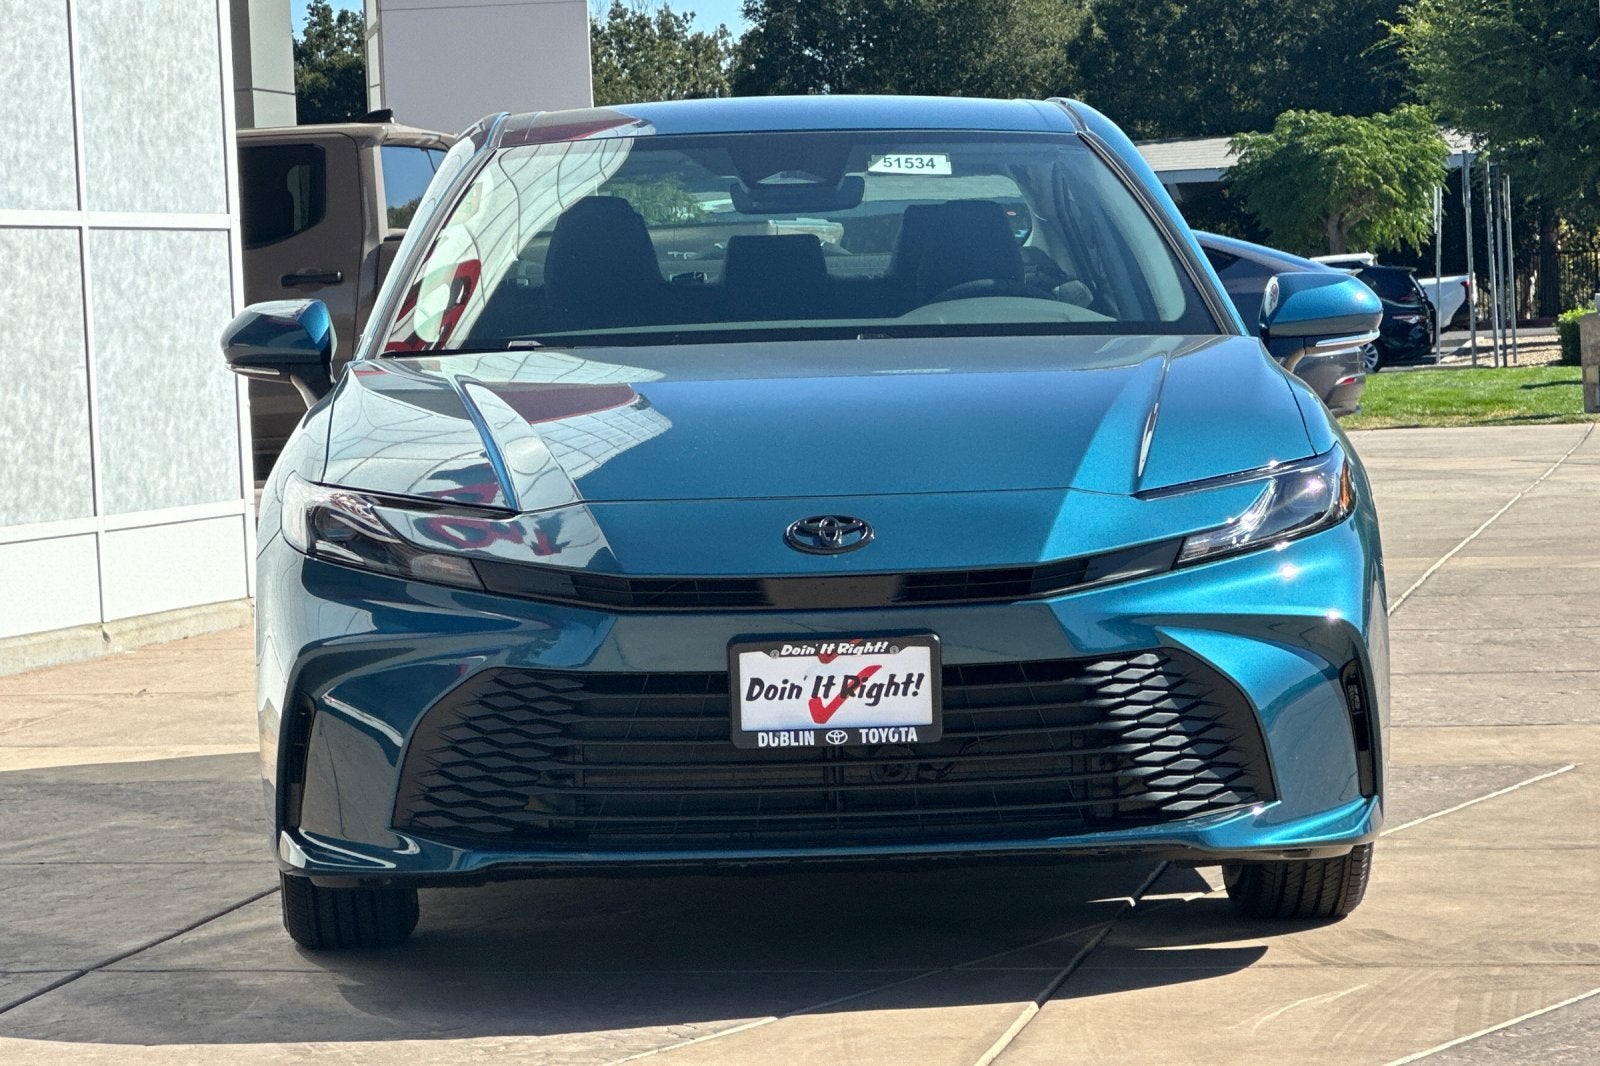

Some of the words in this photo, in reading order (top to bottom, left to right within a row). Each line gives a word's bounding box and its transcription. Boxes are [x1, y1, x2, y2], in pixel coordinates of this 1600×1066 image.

[883, 157, 937, 169] 51534
[780, 643, 819, 656] Doin'
[820, 643, 837, 655] It
[837, 641, 889, 656] Right!
[745, 675, 808, 702] Doin'
[811, 675, 836, 700] It
[840, 672, 925, 707] Right!
[757, 730, 815, 748] DUBLIN
[858, 726, 918, 744] TOYOTA
